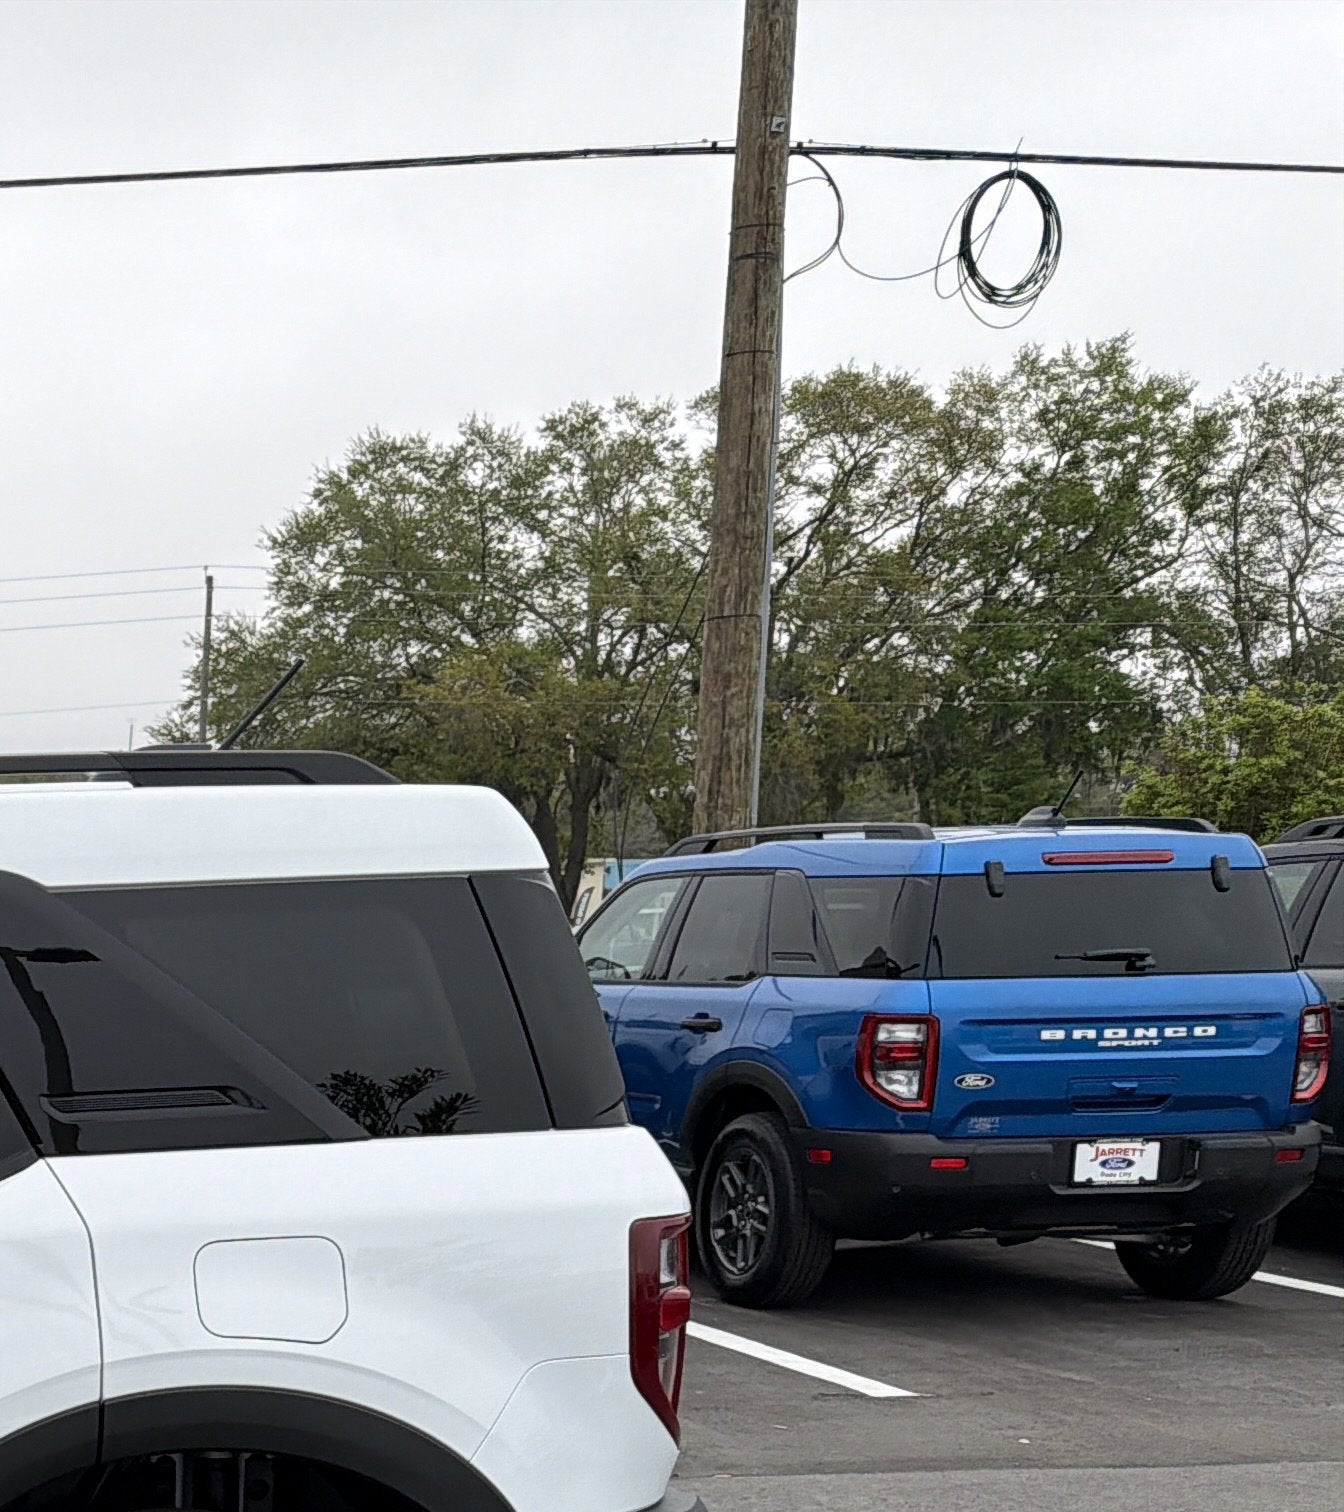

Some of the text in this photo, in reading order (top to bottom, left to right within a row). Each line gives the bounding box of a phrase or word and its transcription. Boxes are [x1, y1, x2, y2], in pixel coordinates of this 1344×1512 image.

[1040, 1026, 1217, 1040] BRONCO
[1097, 1039, 1162, 1048] SPORT
[1089, 1145, 1145, 1162] JARRETT
[1105, 1158, 1129, 1169] Ford
